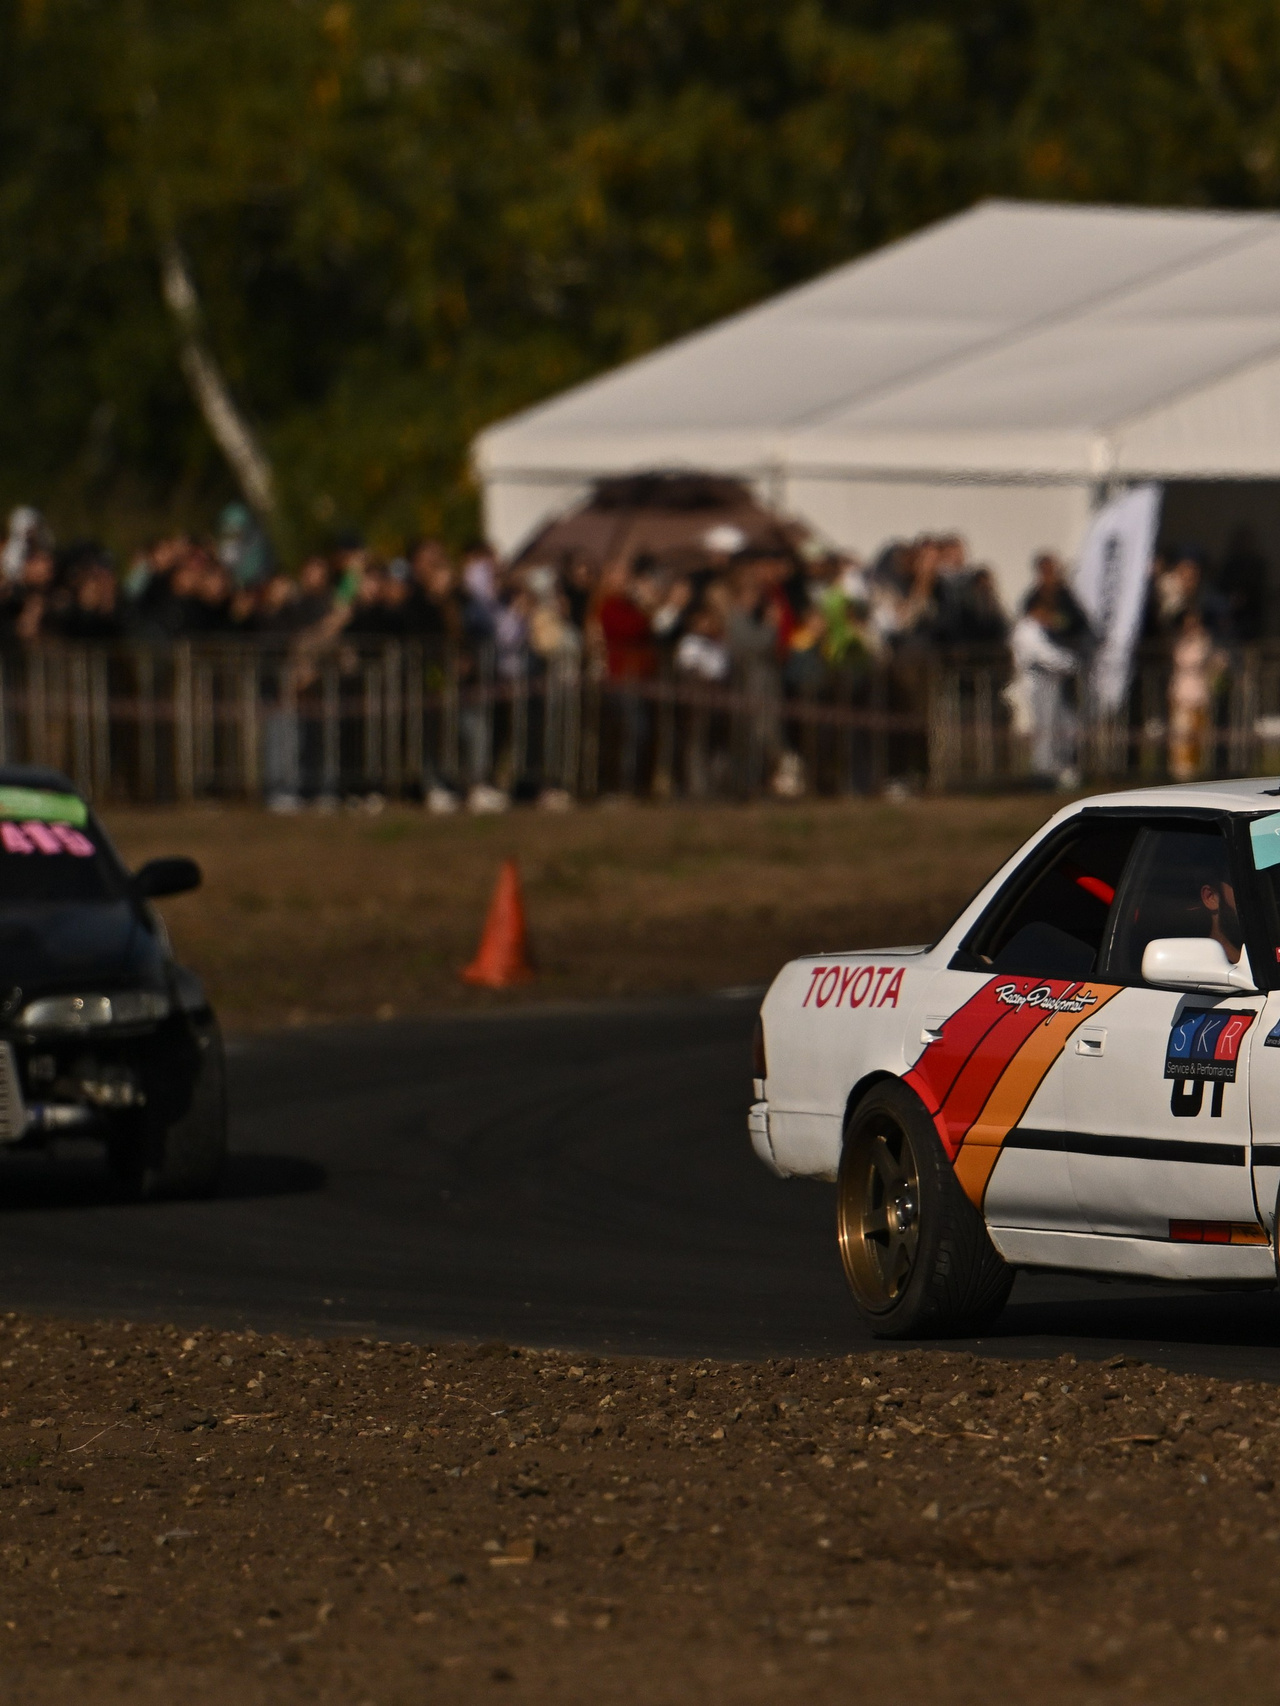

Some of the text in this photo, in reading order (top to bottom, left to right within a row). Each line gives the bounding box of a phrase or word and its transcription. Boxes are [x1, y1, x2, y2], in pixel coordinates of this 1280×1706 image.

[802, 966, 906, 1008] TOYOTA
[995, 983, 1027, 1013] Racing
[1174, 1018, 1242, 1054] SKR
[1166, 1061, 1189, 1074] Service
[1190, 1063, 1196, 1074] &
